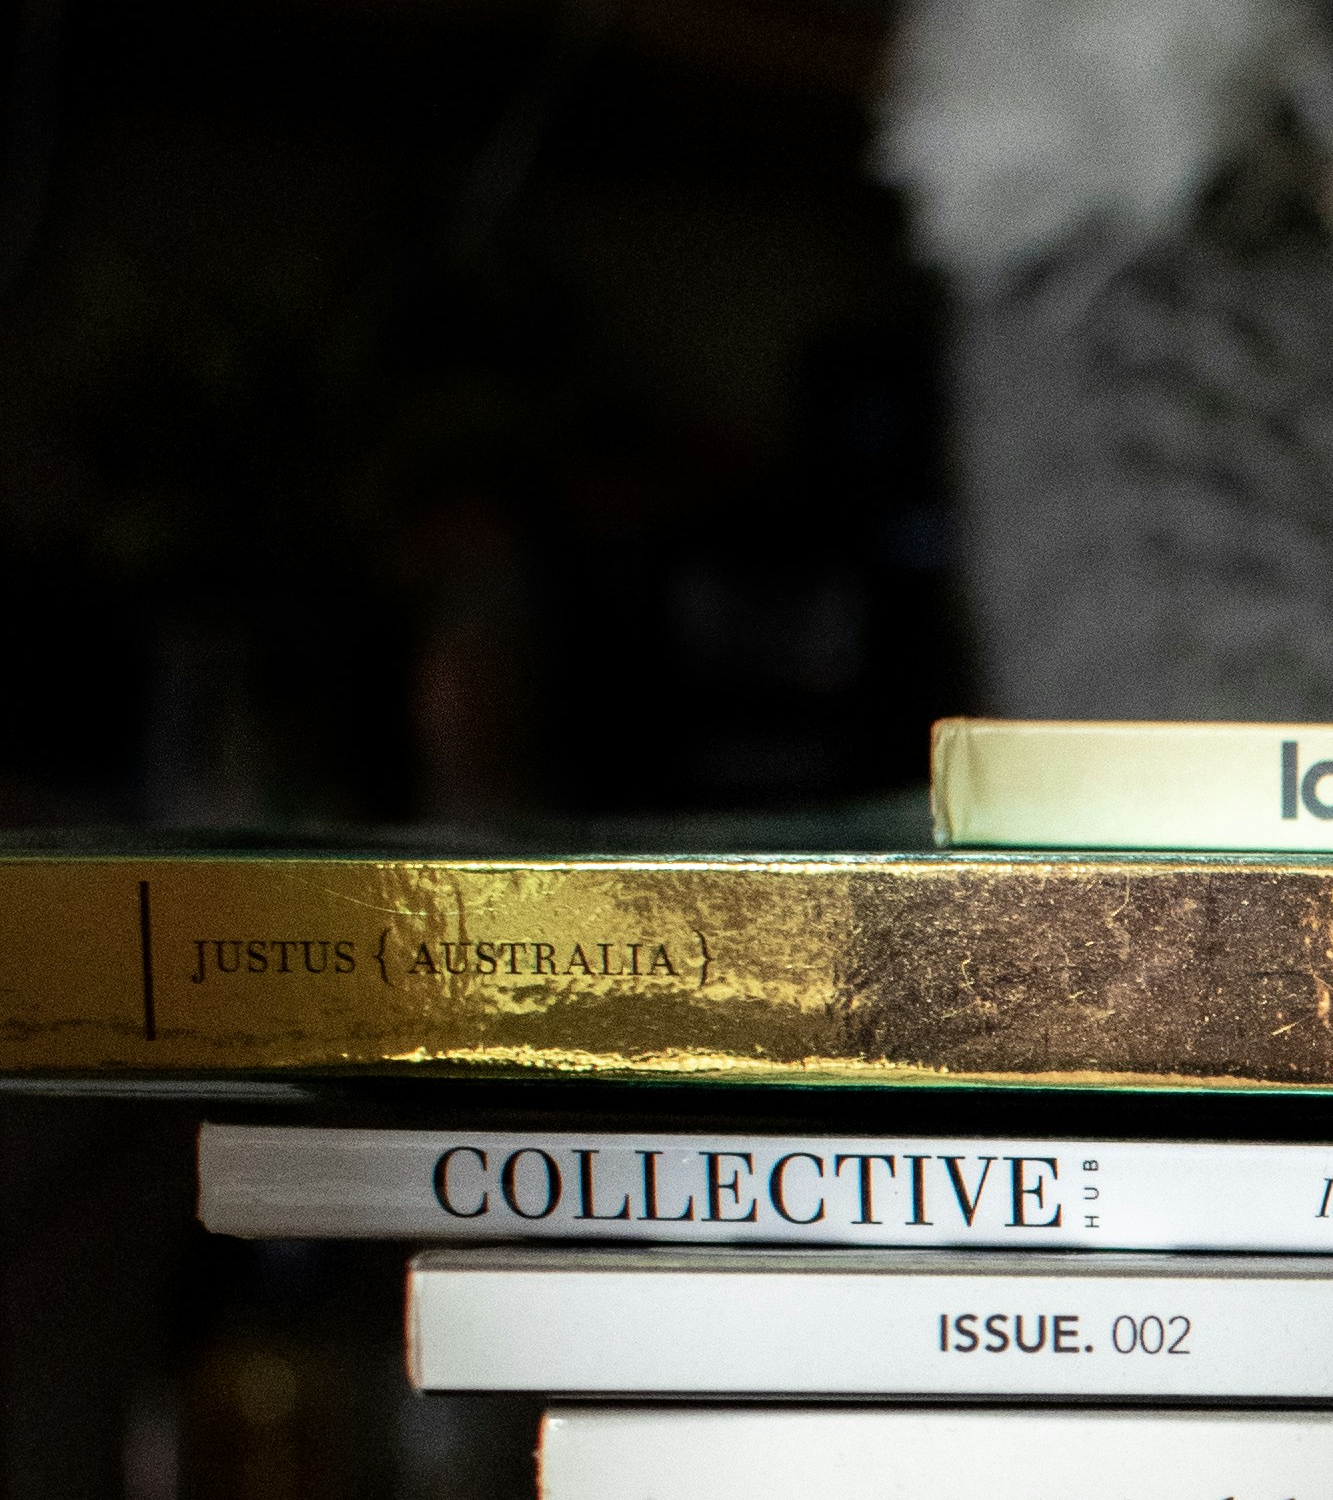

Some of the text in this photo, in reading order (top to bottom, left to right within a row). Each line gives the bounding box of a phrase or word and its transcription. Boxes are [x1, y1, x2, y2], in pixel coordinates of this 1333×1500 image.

[191, 938, 357, 985] JUSTUS
[408, 942, 680, 977] AUSTRALIA
[431, 1146, 1063, 1229] COLLECTIVE
[1080, 1158, 1100, 1230] HUB
[938, 1312, 1193, 1356] ISSUE. 002
